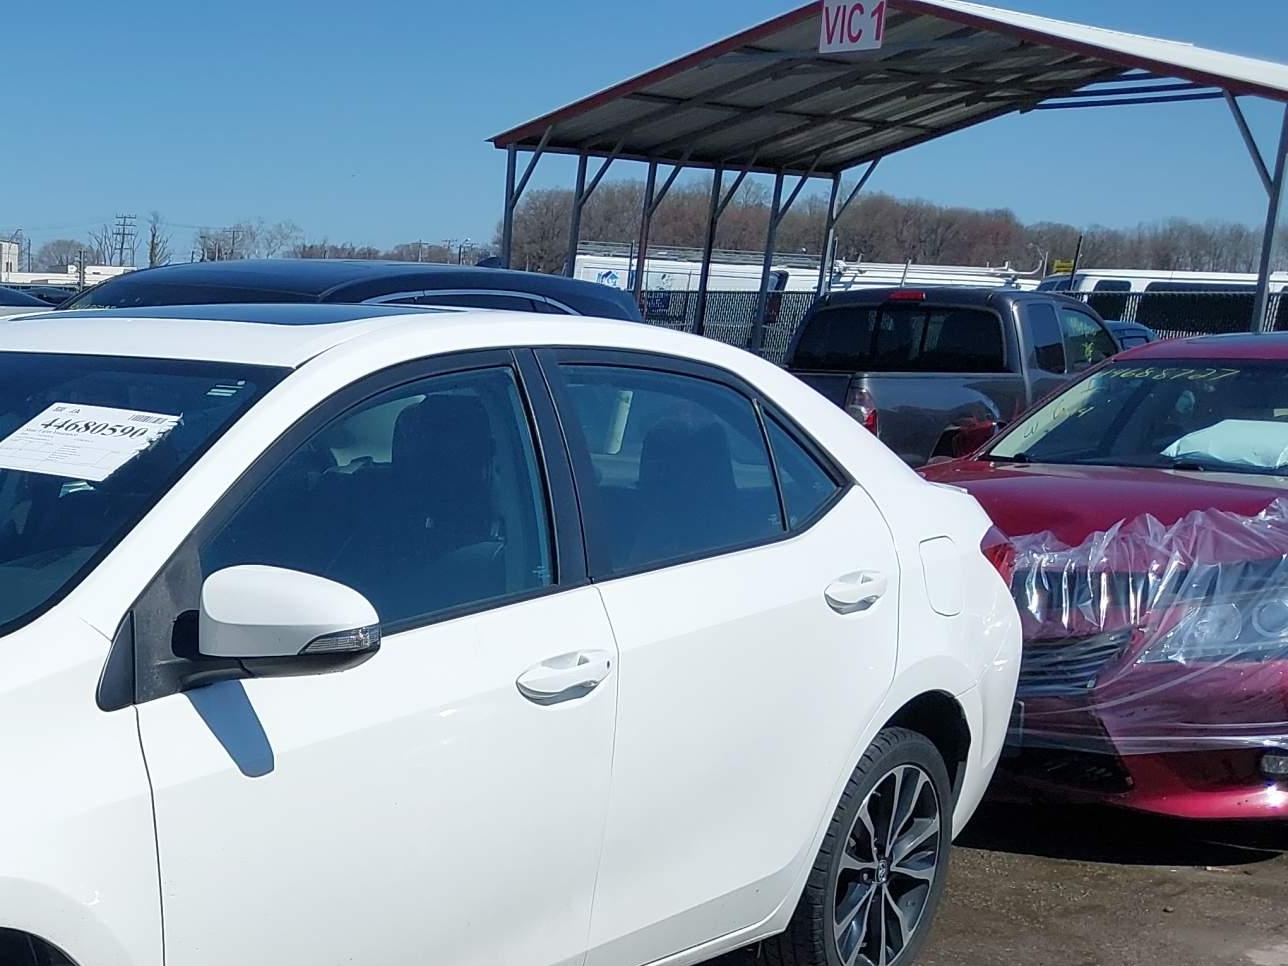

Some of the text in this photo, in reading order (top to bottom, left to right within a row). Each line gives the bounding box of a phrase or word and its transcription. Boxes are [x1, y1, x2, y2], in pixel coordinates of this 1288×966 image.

[824, 0, 884, 45] VIC 1
[41, 416, 148, 439] 44680590
